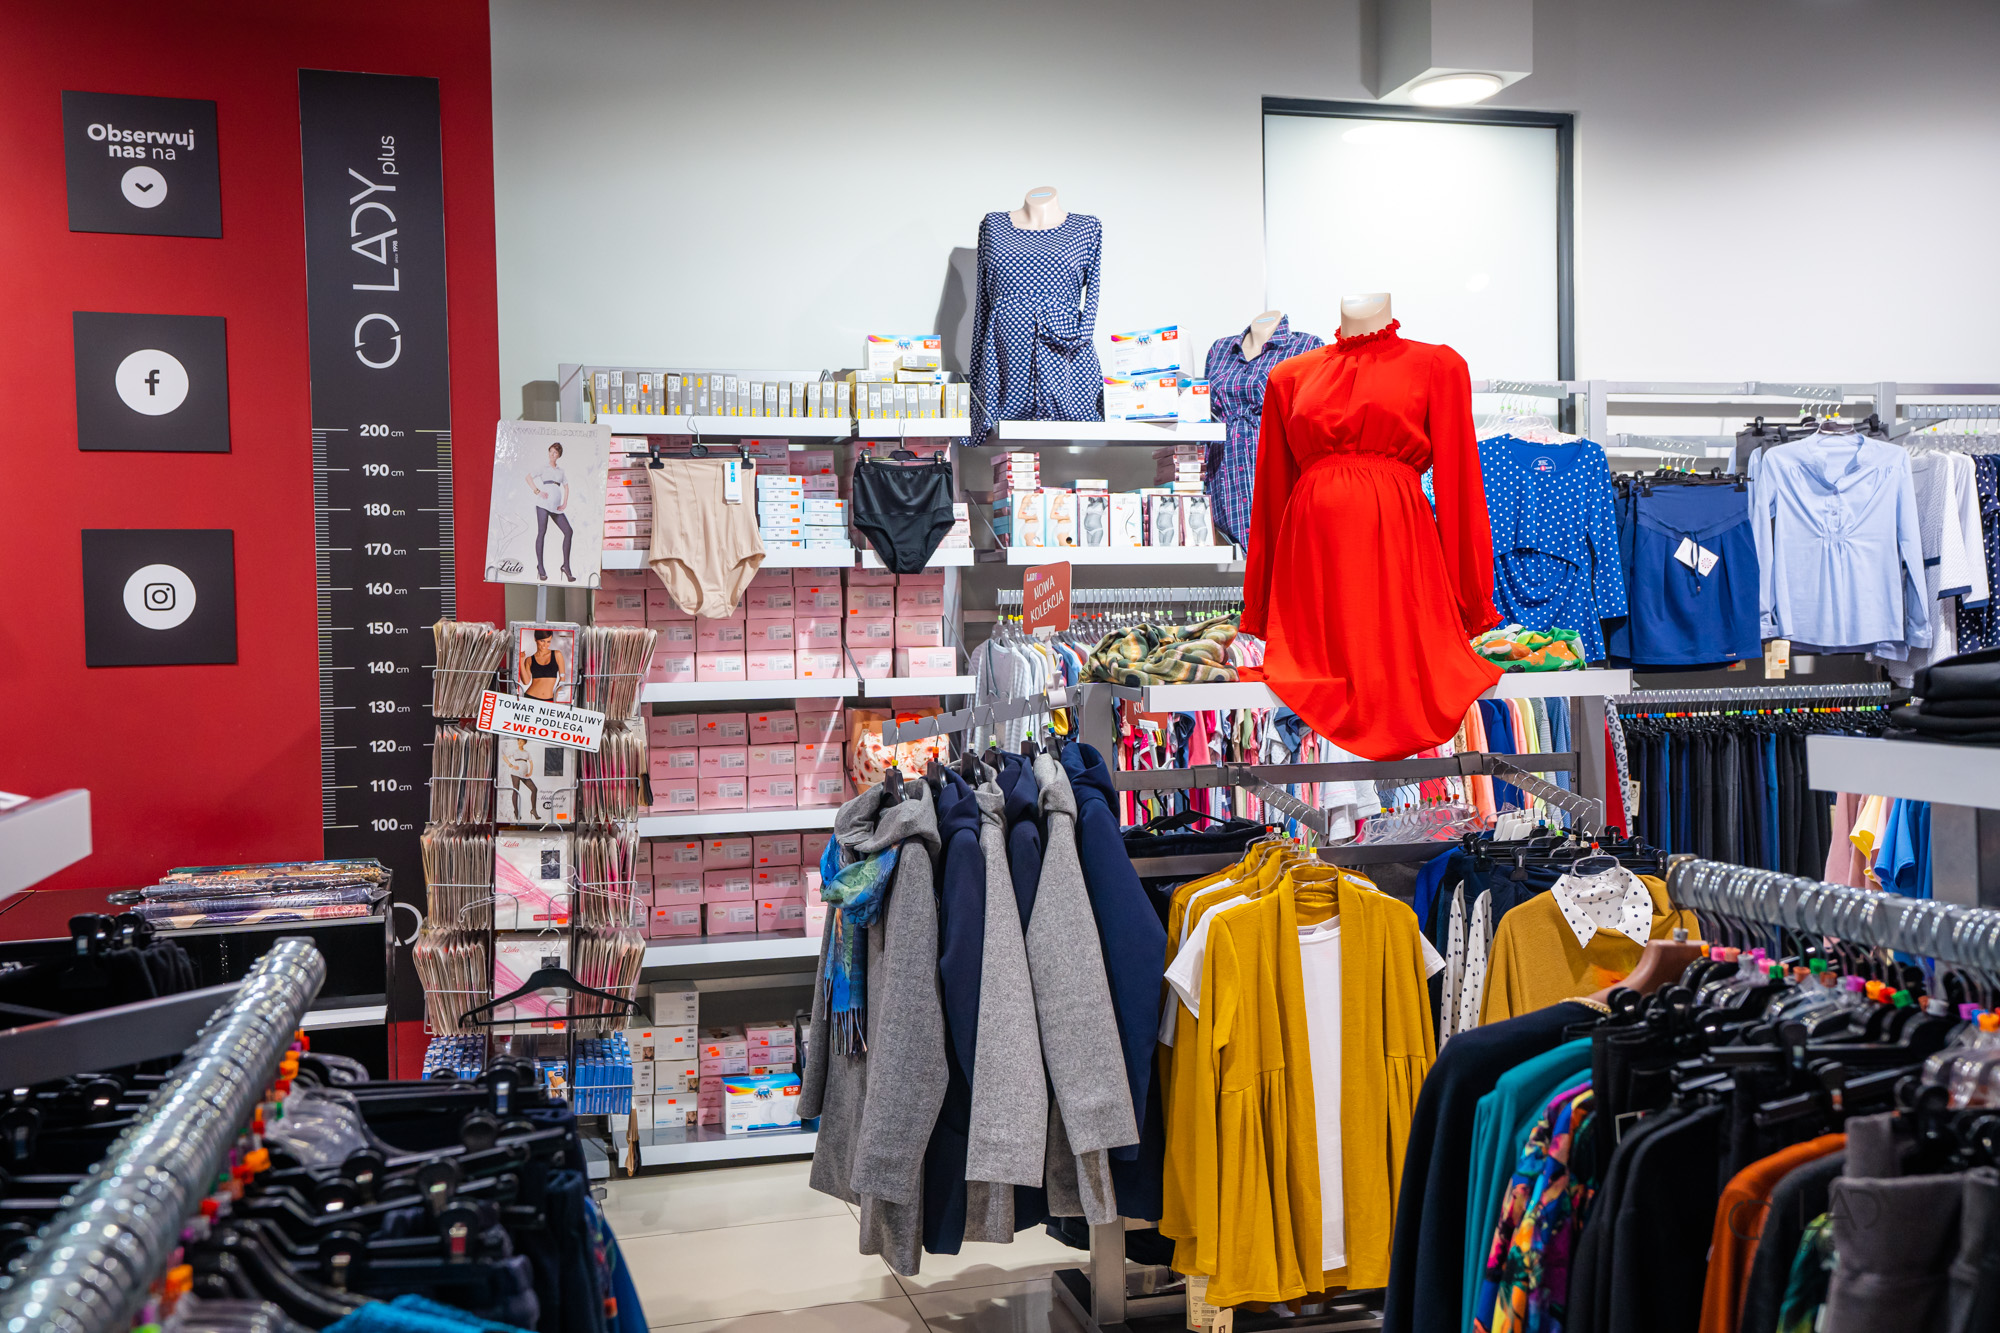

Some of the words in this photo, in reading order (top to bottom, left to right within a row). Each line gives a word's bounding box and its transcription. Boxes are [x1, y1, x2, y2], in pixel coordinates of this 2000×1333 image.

[87, 123, 195, 151] Obserwuj
[108, 144, 146, 159] nas
[152, 147, 176, 161] na
[348, 167, 400, 292] LADY
[377, 135, 400, 176] plus
[359, 423, 390, 438] 200
[390, 430, 405, 438] cm
[361, 463, 390, 477] 190
[362, 502, 391, 517] 180
[391, 509, 406, 517] cm
[364, 542, 392, 556] 170
[392, 548, 407, 556] cm
[498, 560, 524, 574] Lida
[365, 581, 393, 596] 160
[393, 588, 408, 596] cm
[1033, 575, 1055, 601] NOWA
[1030, 590, 1064, 624] KOLEKCJA
[366, 621, 394, 635] 150
[394, 627, 409, 635] cm
[367, 660, 395, 674] 140
[395, 666, 410, 674] cm
[368, 700, 396, 714] 130
[396, 706, 411, 714] cm
[480, 692, 497, 729] UWAGA!
[498, 699, 535, 713] TOWAR
[539, 707, 603, 726] NIEWADLIWY
[513, 713, 531, 723] NIE
[535, 717, 584, 733] PODLEGA
[502, 721, 591, 746] ZWROTOWI
[369, 739, 397, 753] 120
[397, 745, 412, 753] cm
[369, 778, 398, 792] 110
[398, 784, 413, 792] cm
[370, 818, 399, 832] 100
[399, 823, 413, 832] cm
[503, 840, 520, 848] Lida
[502, 945, 520, 954] Lida
